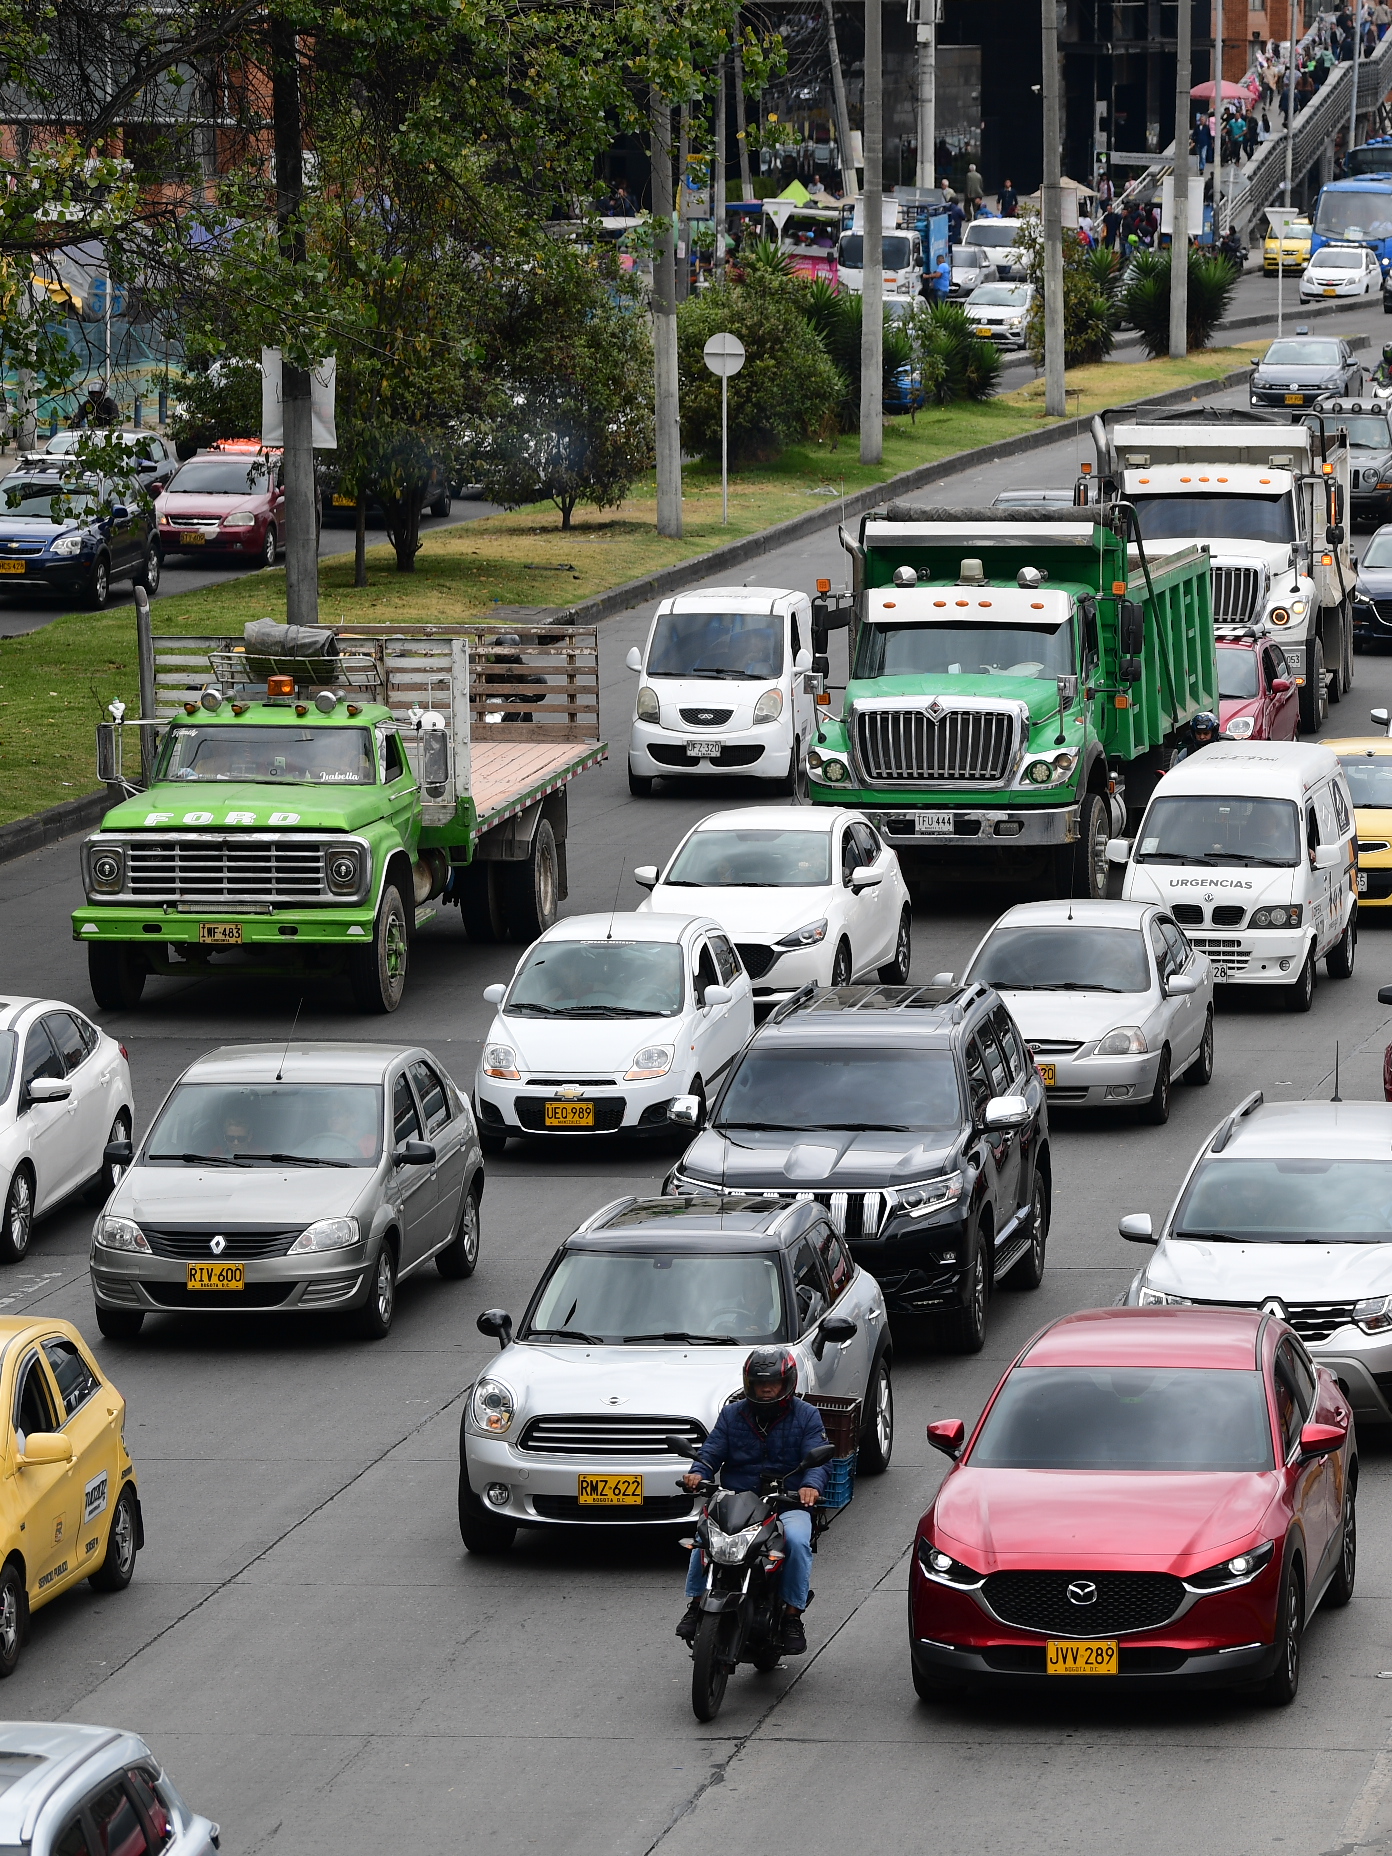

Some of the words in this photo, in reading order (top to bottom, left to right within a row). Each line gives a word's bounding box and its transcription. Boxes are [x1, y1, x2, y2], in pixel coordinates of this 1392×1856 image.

[319, 770, 360, 781] Isabella
[144, 811, 300, 826] FORD
[1169, 878, 1253, 890] URGENCIAS
